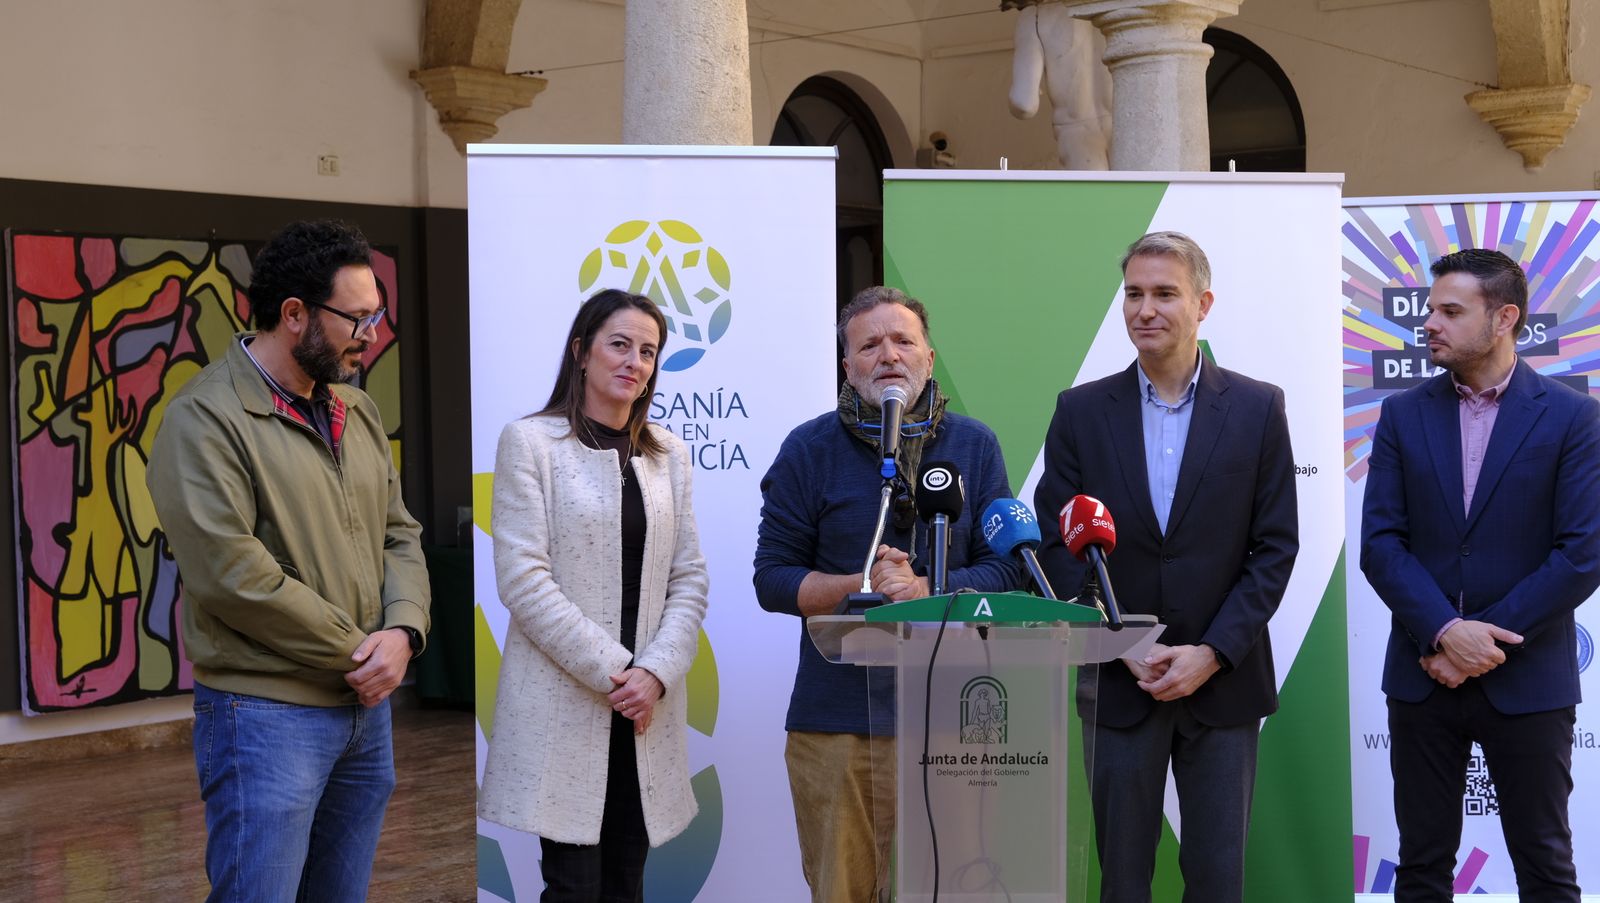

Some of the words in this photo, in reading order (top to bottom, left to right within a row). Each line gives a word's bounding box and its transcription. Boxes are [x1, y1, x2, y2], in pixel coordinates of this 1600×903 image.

[1384, 358, 1413, 378] DE
[649, 387, 750, 420] SANÍA
[683, 423, 709, 441] EN
[1294, 463, 1318, 477] bajo
[1064, 523, 1085, 546] siete
[918, 752, 957, 766] Junta
[960, 752, 978, 765] de
[980, 751, 1049, 765] Andalucía
[936, 768, 979, 778] Delegación
[980, 768, 992, 776] del
[993, 768, 1030, 776] Gobierno
[968, 779, 998, 787] Almería
